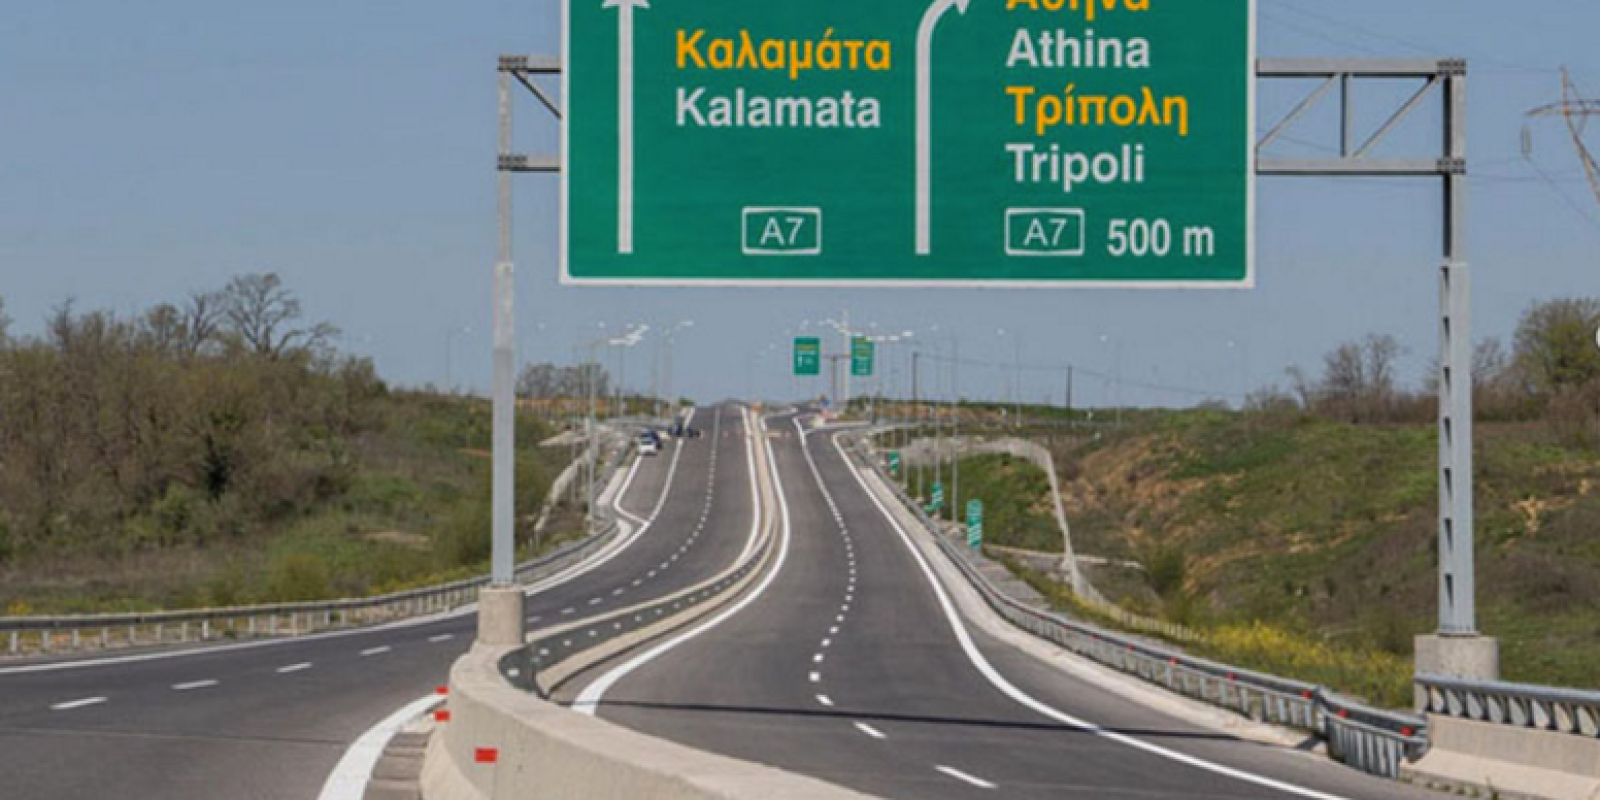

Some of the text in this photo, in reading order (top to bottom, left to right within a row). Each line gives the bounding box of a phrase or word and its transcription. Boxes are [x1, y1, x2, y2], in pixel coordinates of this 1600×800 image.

[676, 28, 891, 78] Καλαμάτα
[1006, 29, 1149, 68] Athina
[676, 87, 880, 128] Kalamata
[1006, 84, 1189, 135] Τρίπολη
[1006, 143, 1144, 192] Tripoli
[760, 217, 804, 245] A7
[1024, 217, 1067, 245] A7
[1107, 219, 1214, 256] 500 m
